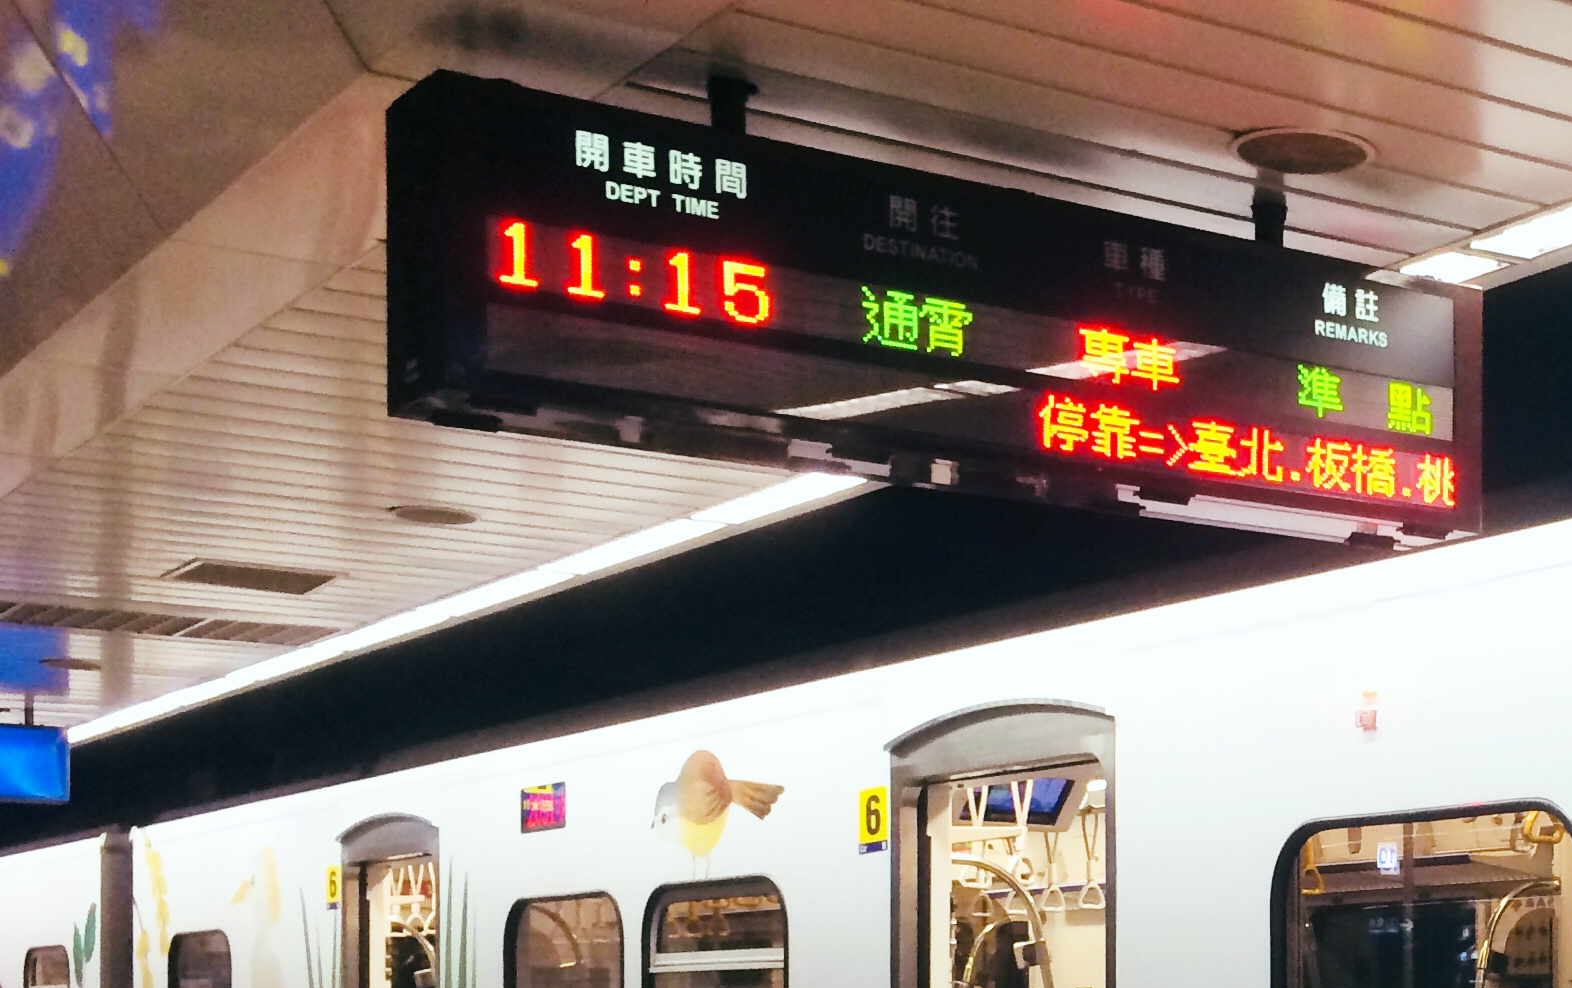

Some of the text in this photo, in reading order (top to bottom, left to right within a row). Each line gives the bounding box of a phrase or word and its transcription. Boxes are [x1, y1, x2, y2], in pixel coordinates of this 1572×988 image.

[575, 129, 747, 199] 開車時間
[606, 181, 719, 220] DEPT TIME
[888, 194, 959, 242] 開往
[863, 232, 979, 271] DESTINATION
[497, 220, 771, 325] 11:15
[861, 284, 973, 357] 通霄
[1322, 282, 1379, 323] 備註
[1314, 319, 1388, 348] REMARKS
[1079, 327, 1180, 390] 專車
[866, 794, 881, 835] 6
[329, 870, 337, 898] 6
